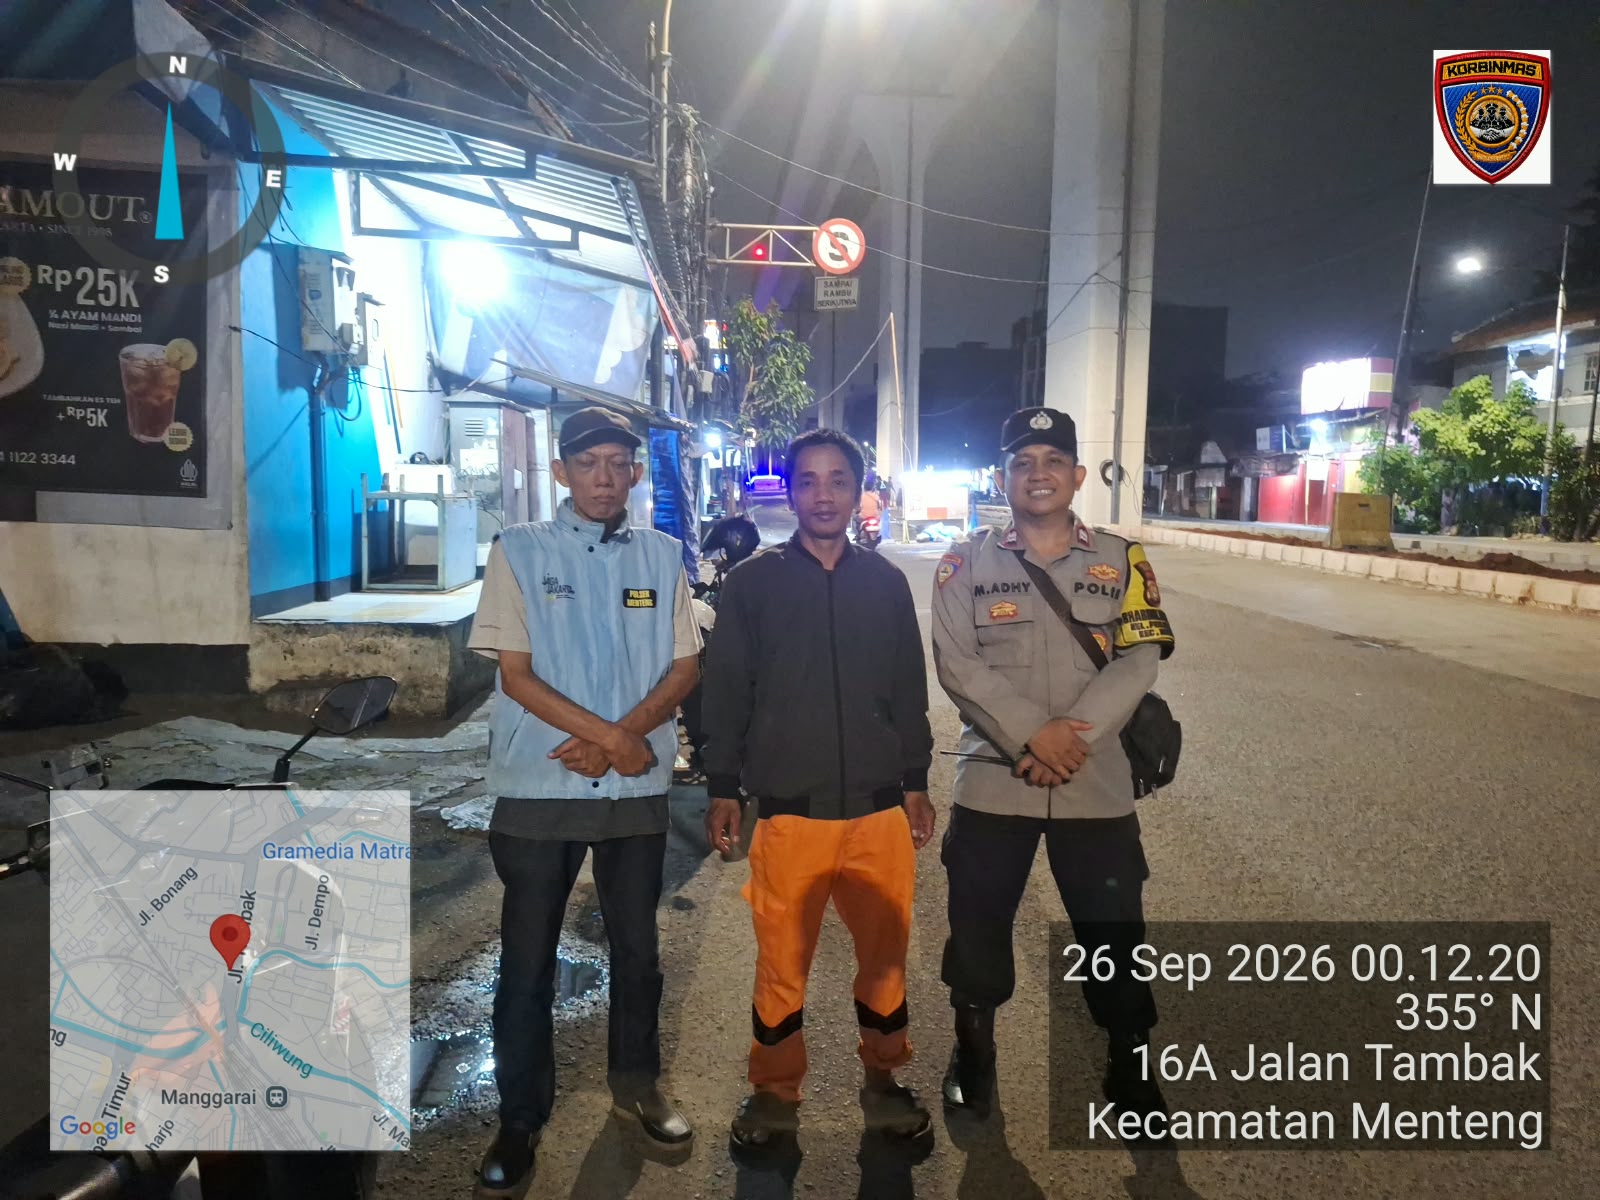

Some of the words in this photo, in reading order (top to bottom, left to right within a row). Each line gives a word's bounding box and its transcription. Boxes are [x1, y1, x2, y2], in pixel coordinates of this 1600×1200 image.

[823, 280, 853, 289] SAMPAI
[823, 289, 852, 298] RAMBU
[818, 298, 857, 307] BERIKUTNYA
[61, 310, 98, 321] AYAM
[101, 311, 142, 323] MANDI
[10, 451, 37, 464] 1122
[40, 452, 76, 465] 3344
